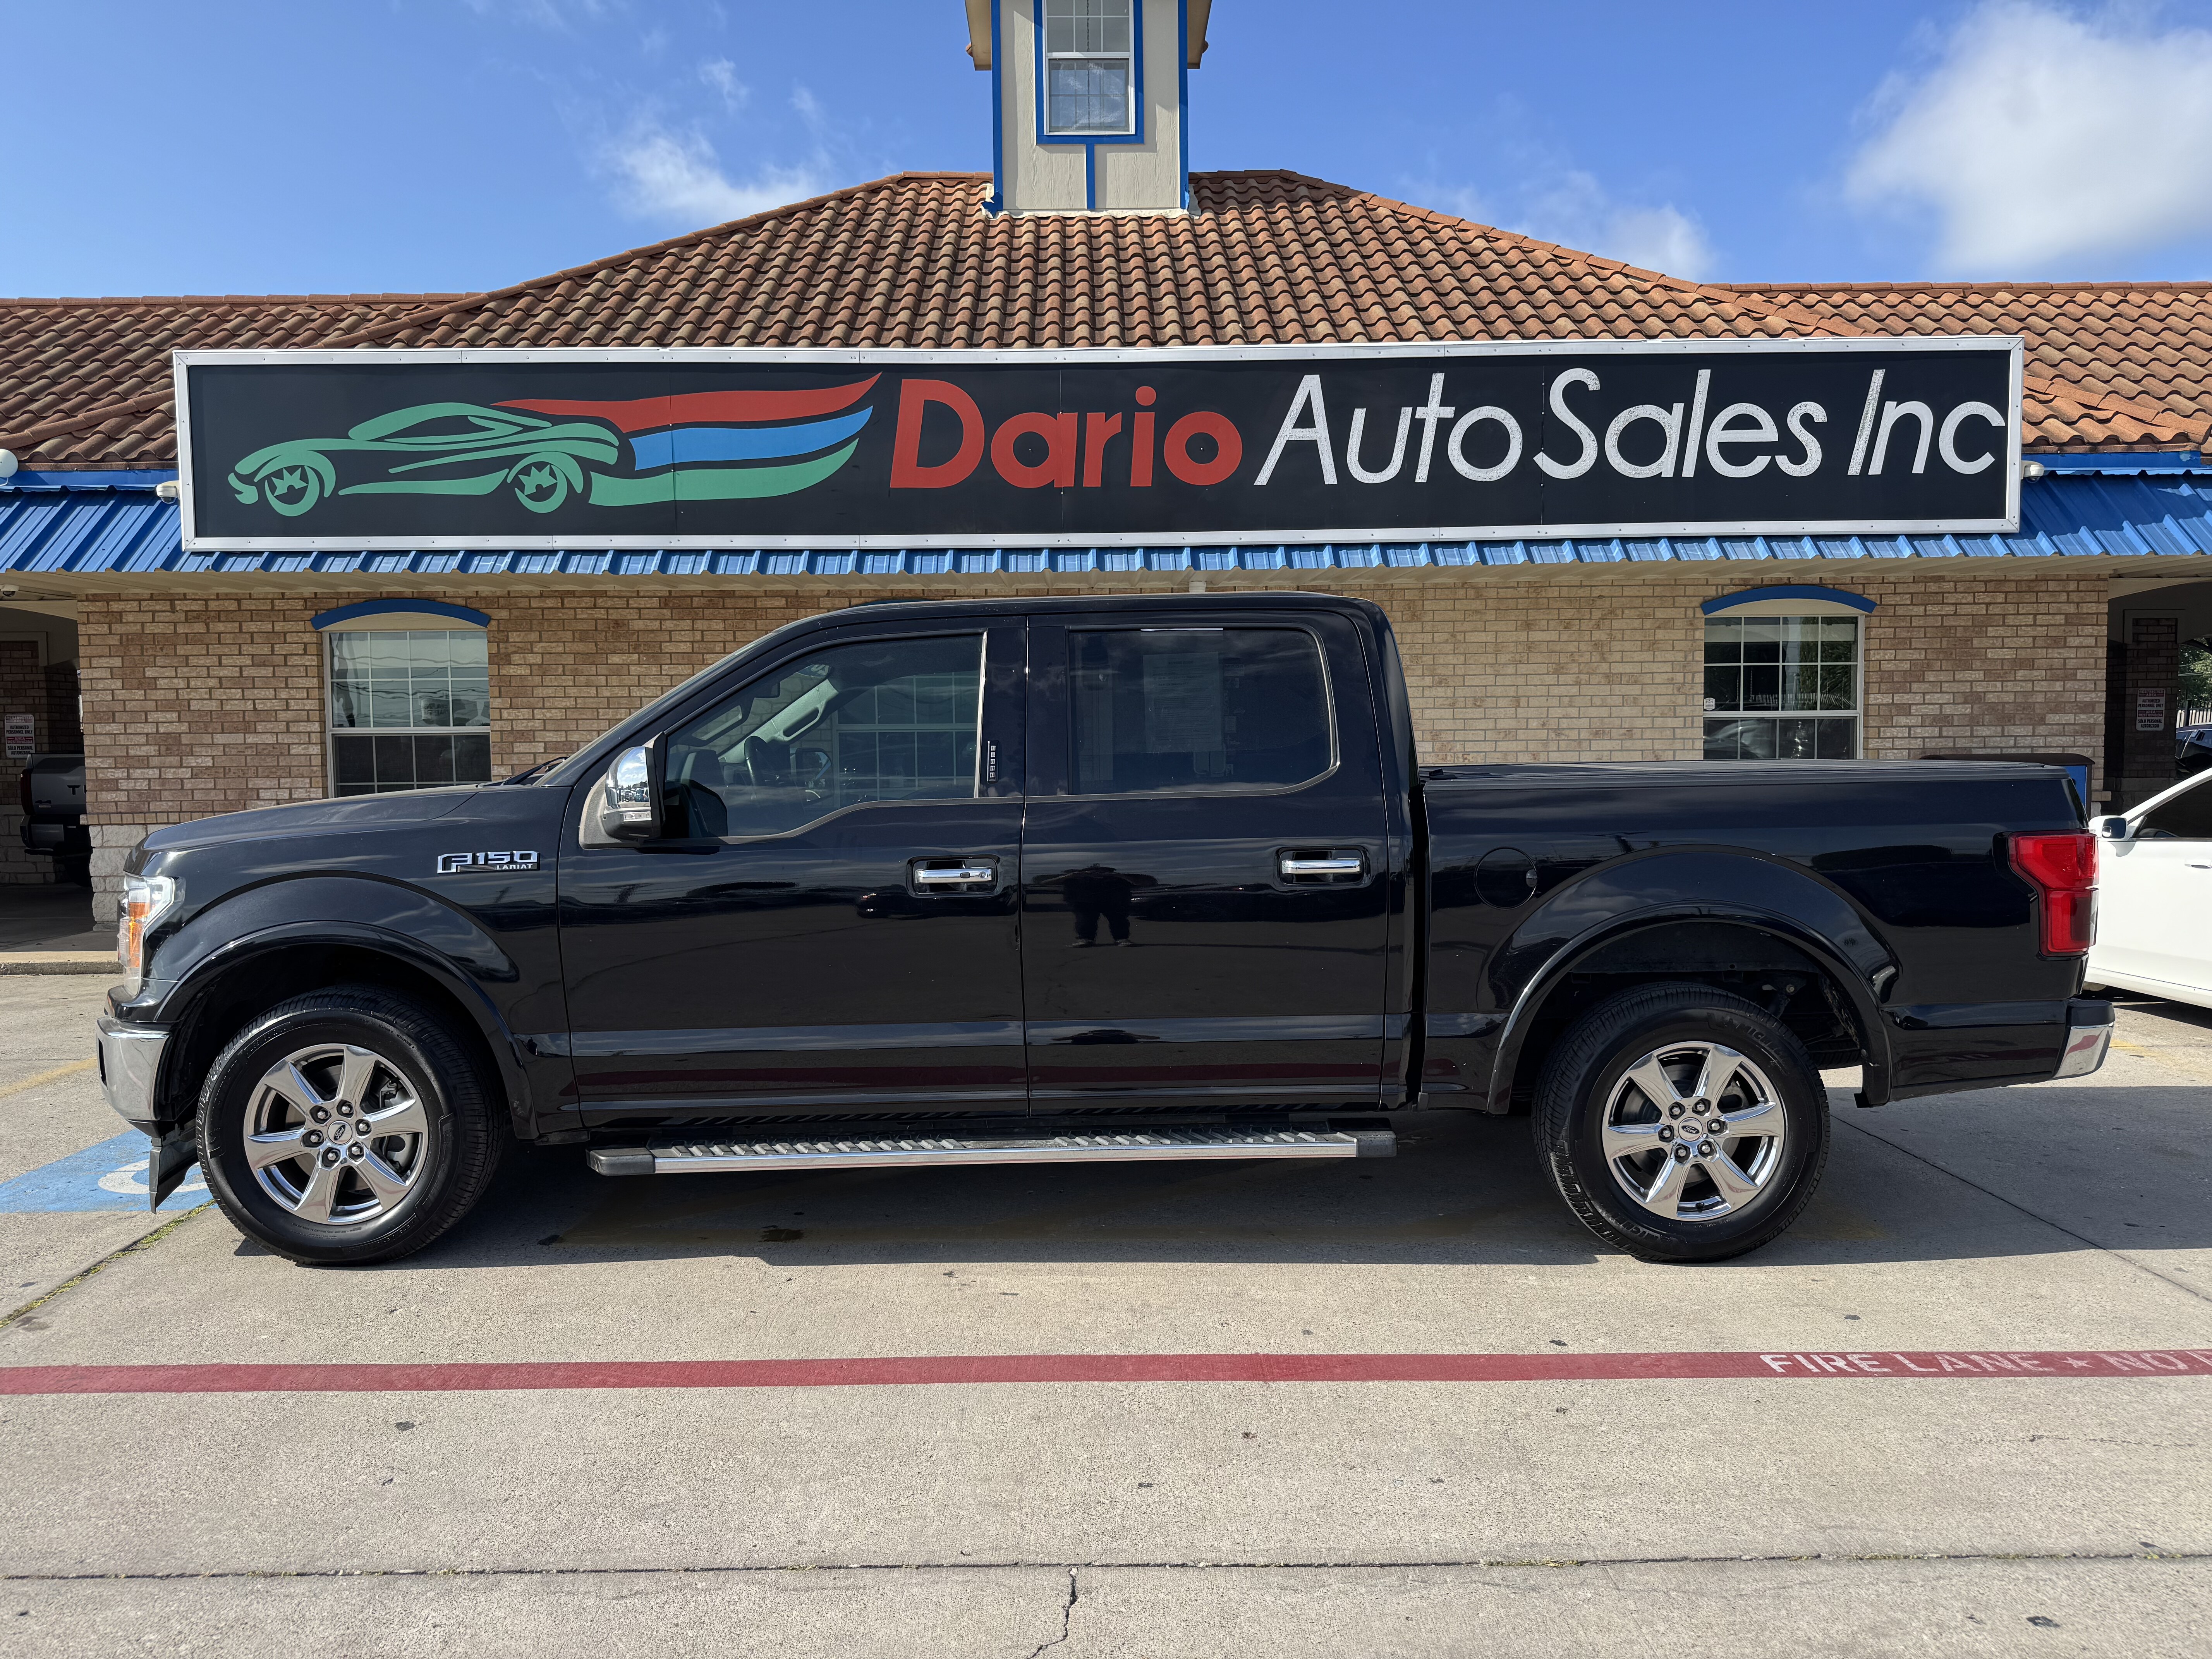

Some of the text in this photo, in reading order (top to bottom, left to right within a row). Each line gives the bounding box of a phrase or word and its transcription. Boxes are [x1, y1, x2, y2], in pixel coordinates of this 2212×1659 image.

[889, 368, 2005, 488] Dario Auto Sales Inc
[335, 1127, 344, 1139] Ford
[1759, 1354, 1893, 1373] FIRE
[1889, 1353, 2056, 1372] LANE
[2097, 1352, 2190, 1371] NO
